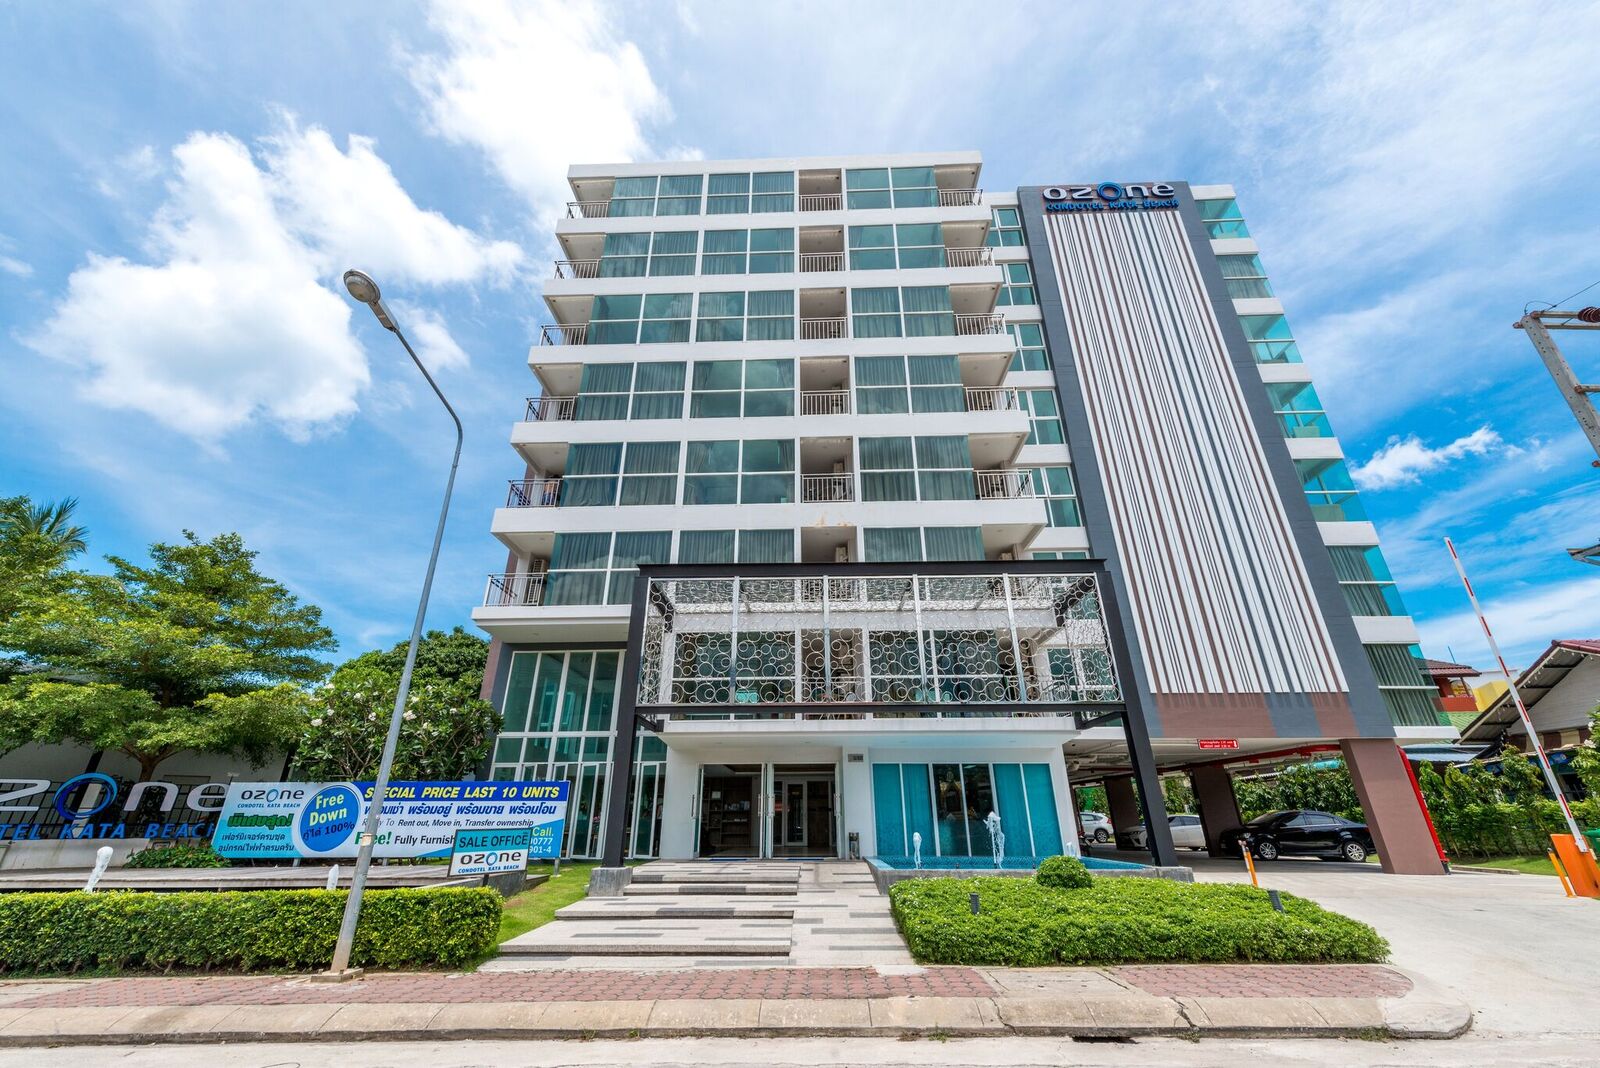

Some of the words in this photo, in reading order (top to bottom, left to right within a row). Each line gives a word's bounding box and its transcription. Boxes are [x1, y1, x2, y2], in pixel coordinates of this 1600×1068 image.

[1046, 201, 1103, 212] CONDOTEL
[1143, 199, 1179, 209] BEACH
[364, 787, 416, 799] SECIAL
[421, 787, 460, 798] PRICE
[464, 787, 497, 798] LAST
[502, 787, 517, 798] 10
[522, 787, 560, 798] UNITS
[315, 793, 345, 810] Free
[309, 807, 348, 826] Down
[408, 802, 453, 817] พร้อมอยู่
[456, 802, 505, 815] พร้อมขาย
[509, 802, 557, 815] พร้อมโอน
[324, 821, 355, 835] 100%
[385, 818, 395, 826] To
[398, 819, 415, 827] Rent
[416, 819, 430, 828] out,
[432, 819, 452, 827] Move
[453, 819, 462, 828] in,
[465, 819, 495, 827] Transfer
[496, 819, 534, 828] ownership
[58, 822, 126, 840] KATA
[354, 831, 392, 845] Fee!
[394, 834, 418, 847] Fully
[459, 836, 488, 849] SALE
[490, 834, 529, 847] OFFICE
[457, 866, 486, 874] CONDOTEL
